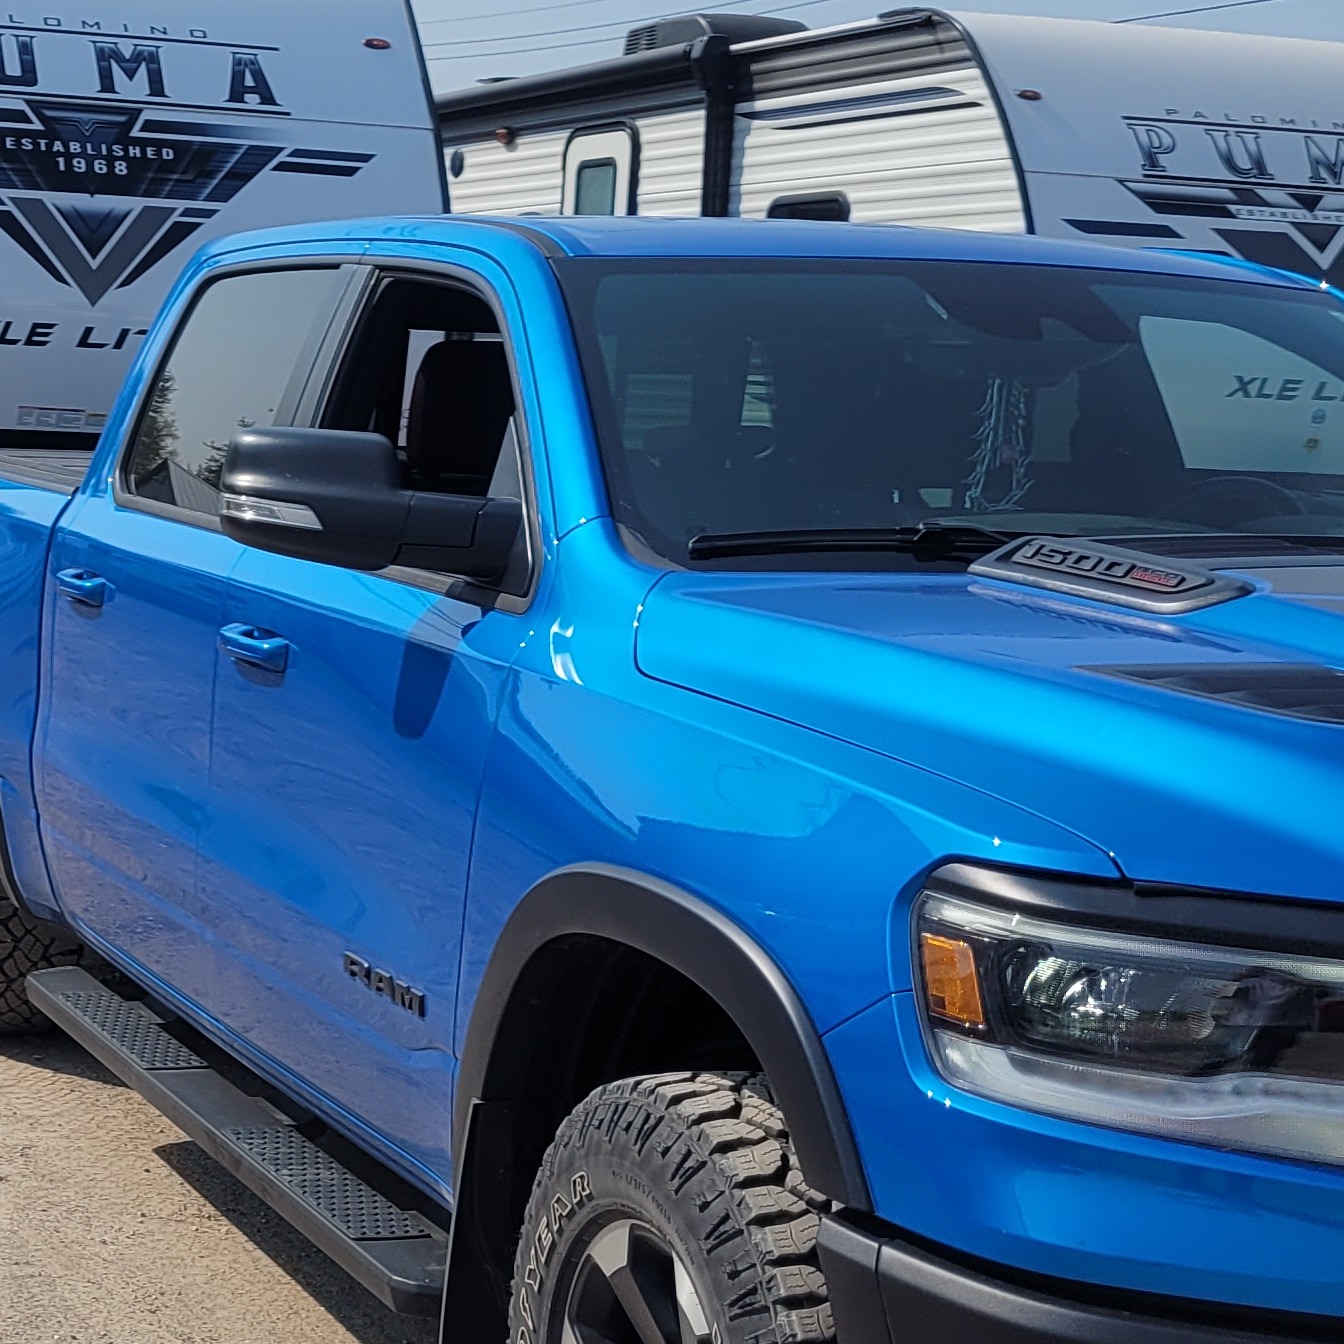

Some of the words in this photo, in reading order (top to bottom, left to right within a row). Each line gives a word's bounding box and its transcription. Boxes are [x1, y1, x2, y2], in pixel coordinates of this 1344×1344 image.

[5, 136, 175, 161] ESTABLISHED
[55, 156, 129, 176] 1968
[1224, 374, 1305, 401] XLE
[1310, 381, 1344, 403] L
[1021, 540, 1138, 579] 1500
[342, 950, 426, 1022] RAM
